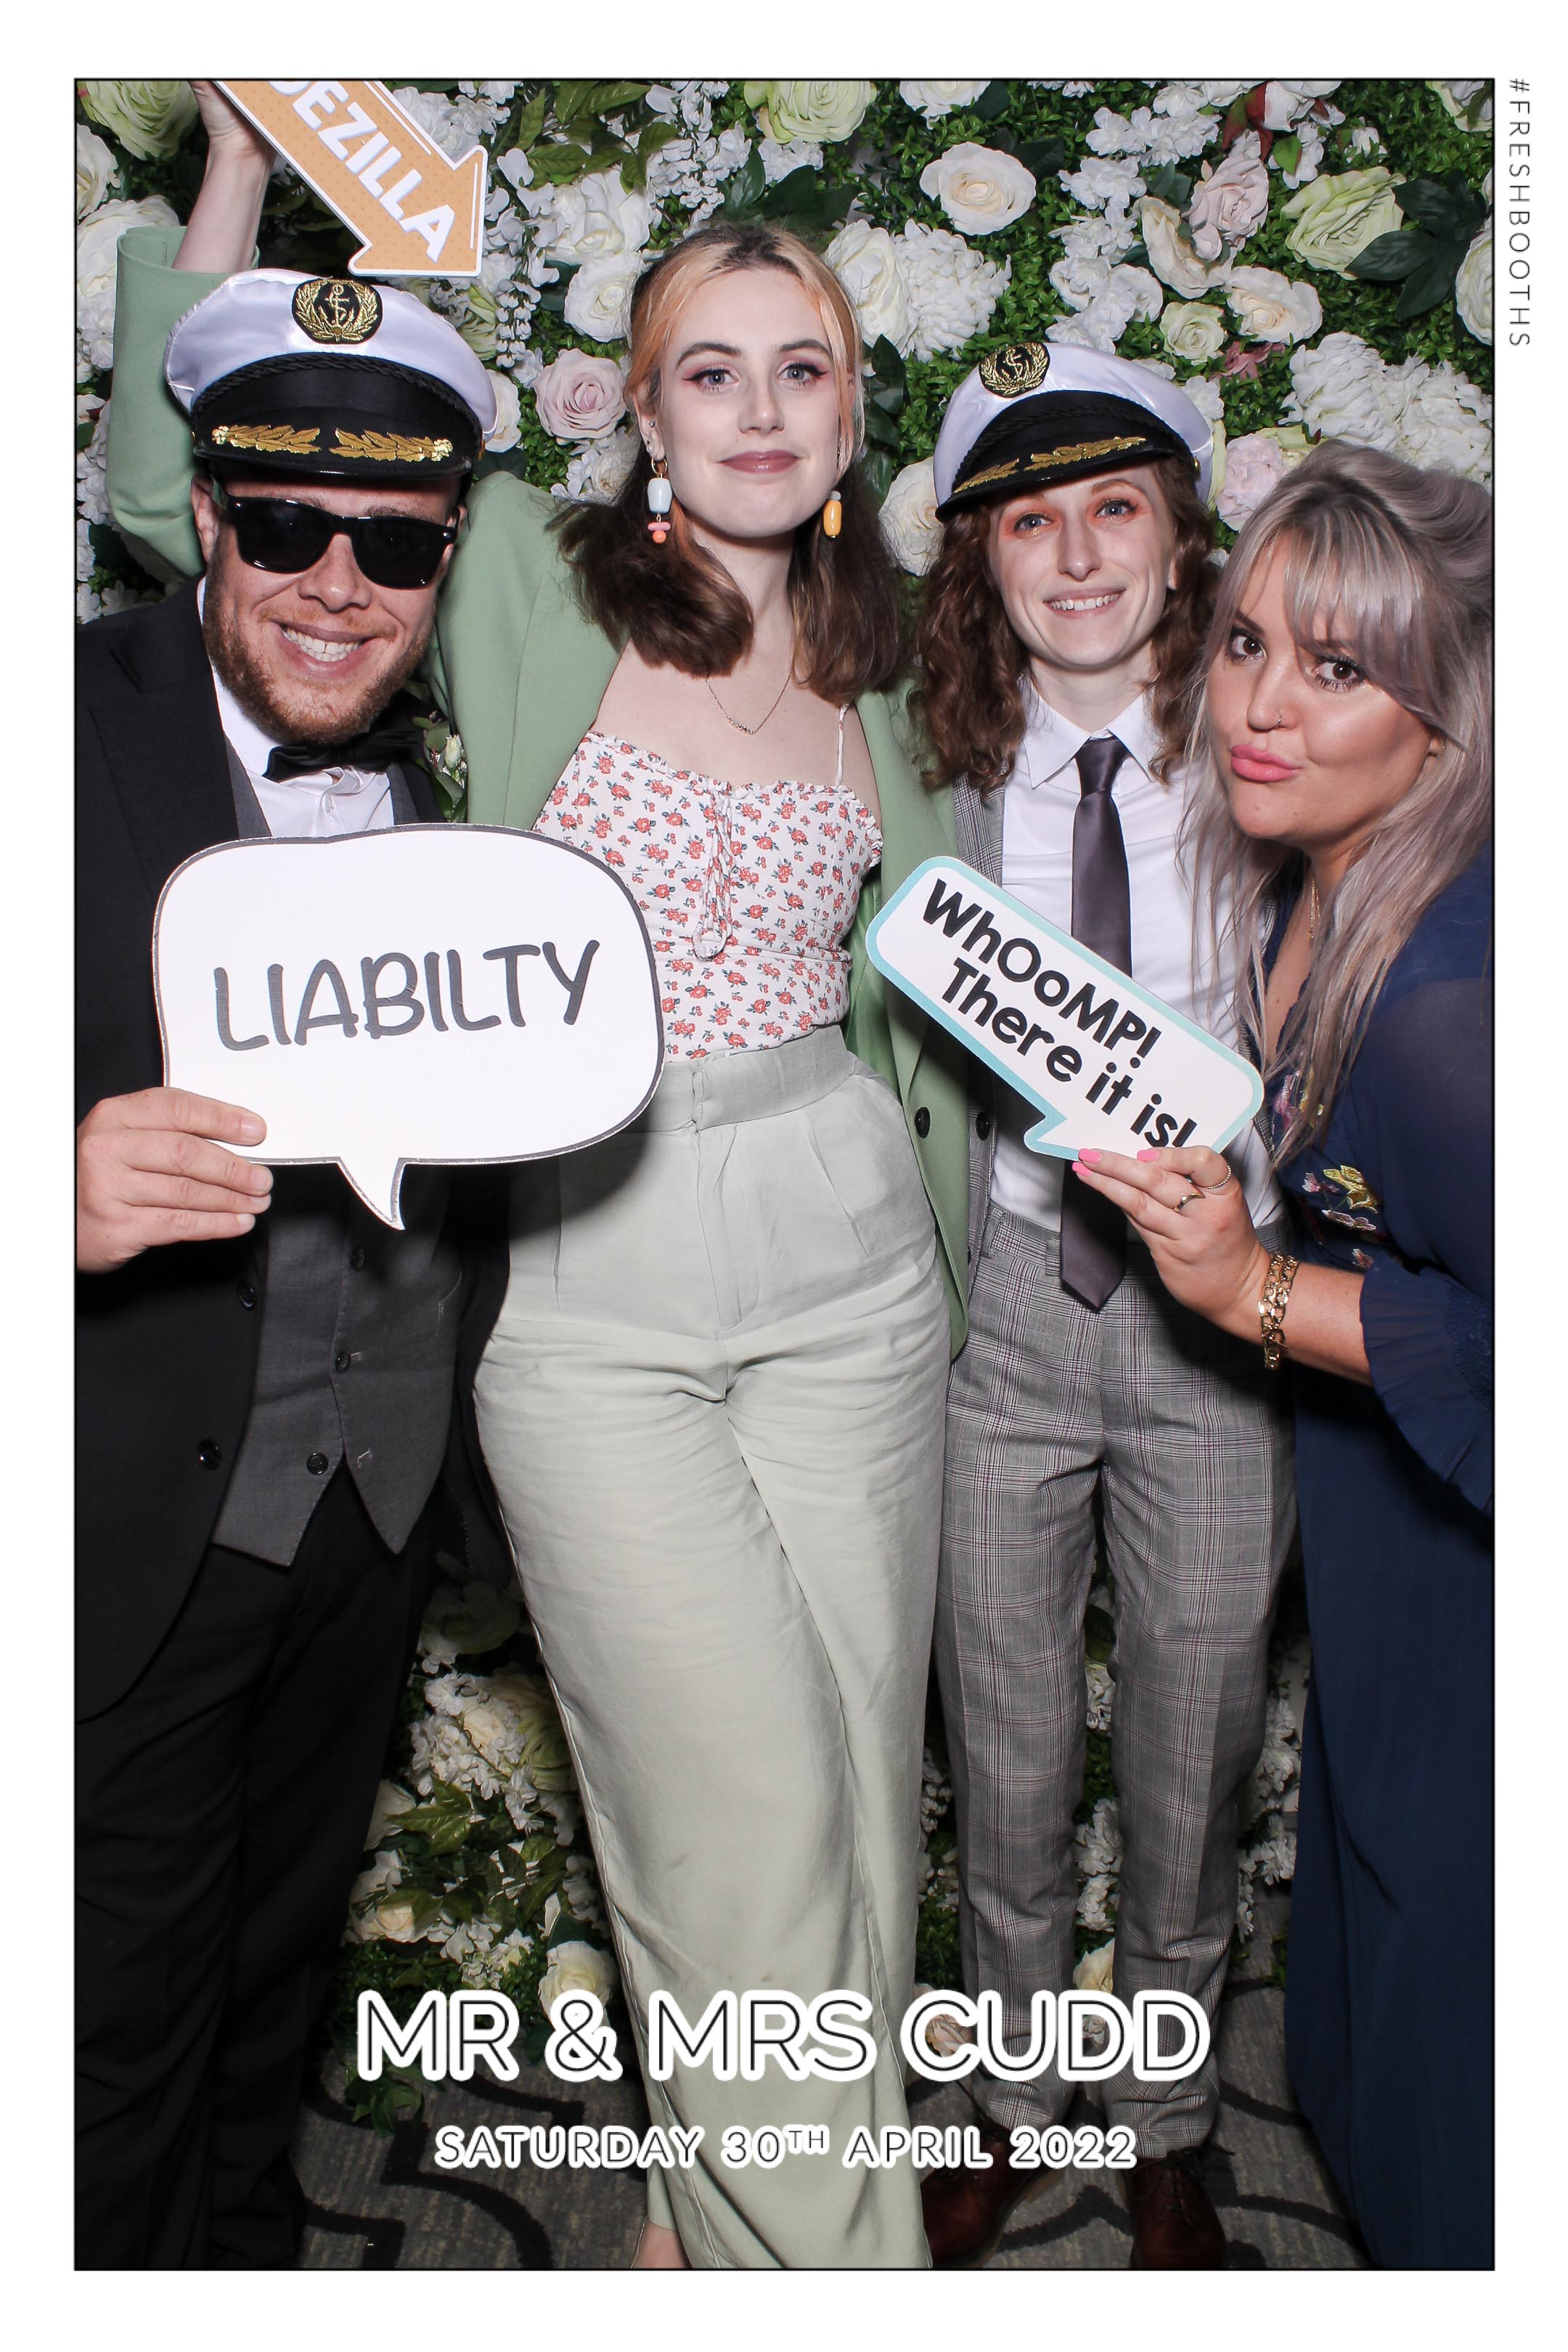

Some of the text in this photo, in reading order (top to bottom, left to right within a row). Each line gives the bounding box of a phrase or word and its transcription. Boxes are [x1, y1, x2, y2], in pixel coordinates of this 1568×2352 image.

[268, 81, 456, 264] EZILLA
[213, 939, 600, 1051] LIABILTY
[942, 957, 1082, 1082] There
[1085, 1061, 1133, 1116] it
